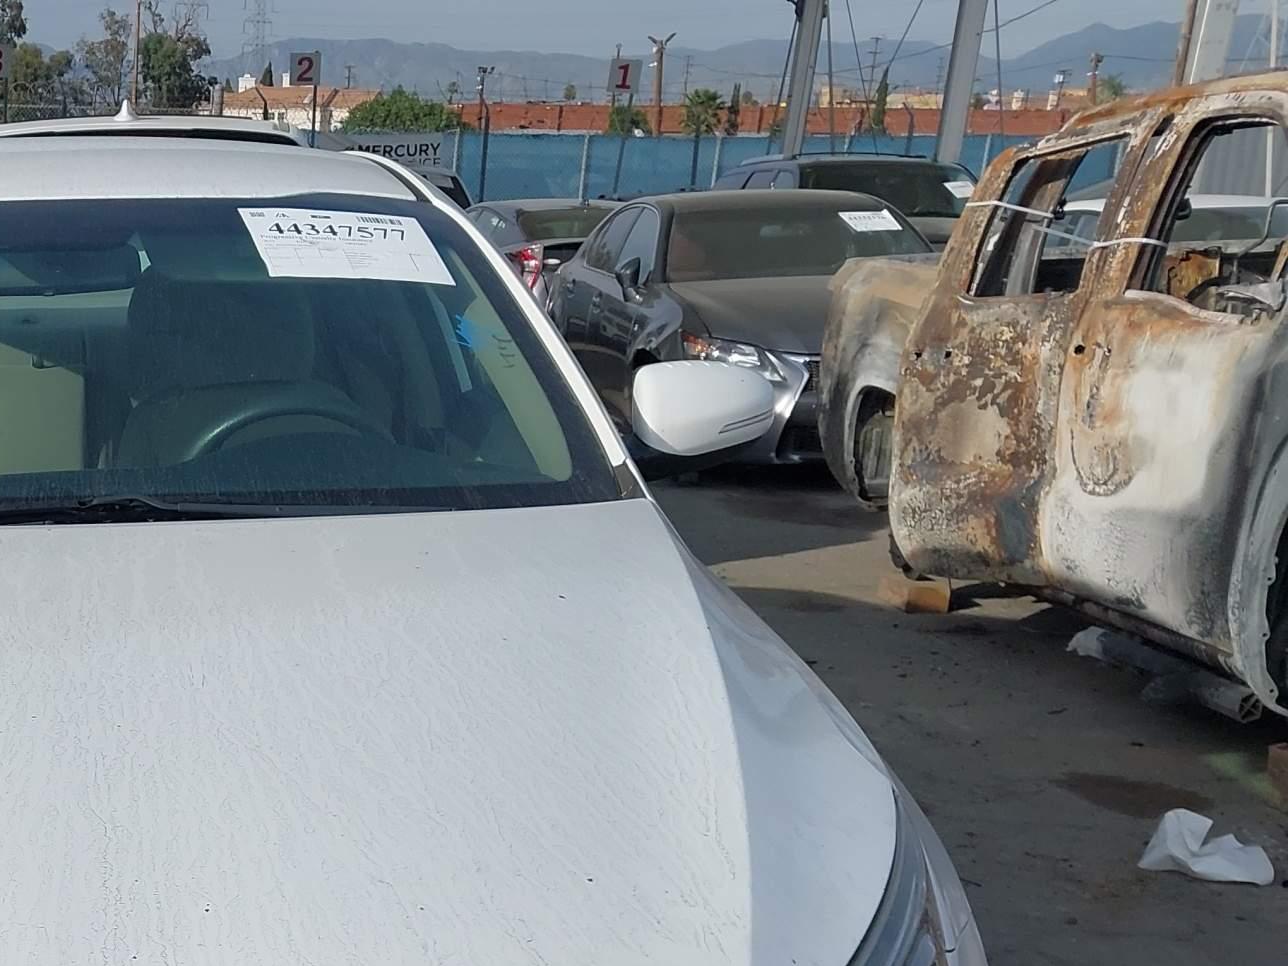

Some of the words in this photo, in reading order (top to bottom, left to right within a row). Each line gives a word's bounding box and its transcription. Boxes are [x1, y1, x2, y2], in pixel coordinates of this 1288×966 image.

[297, 56, 313, 82] 2
[615, 63, 631, 89] 1
[358, 142, 441, 158] MERCURY
[268, 222, 405, 241] 44347577
